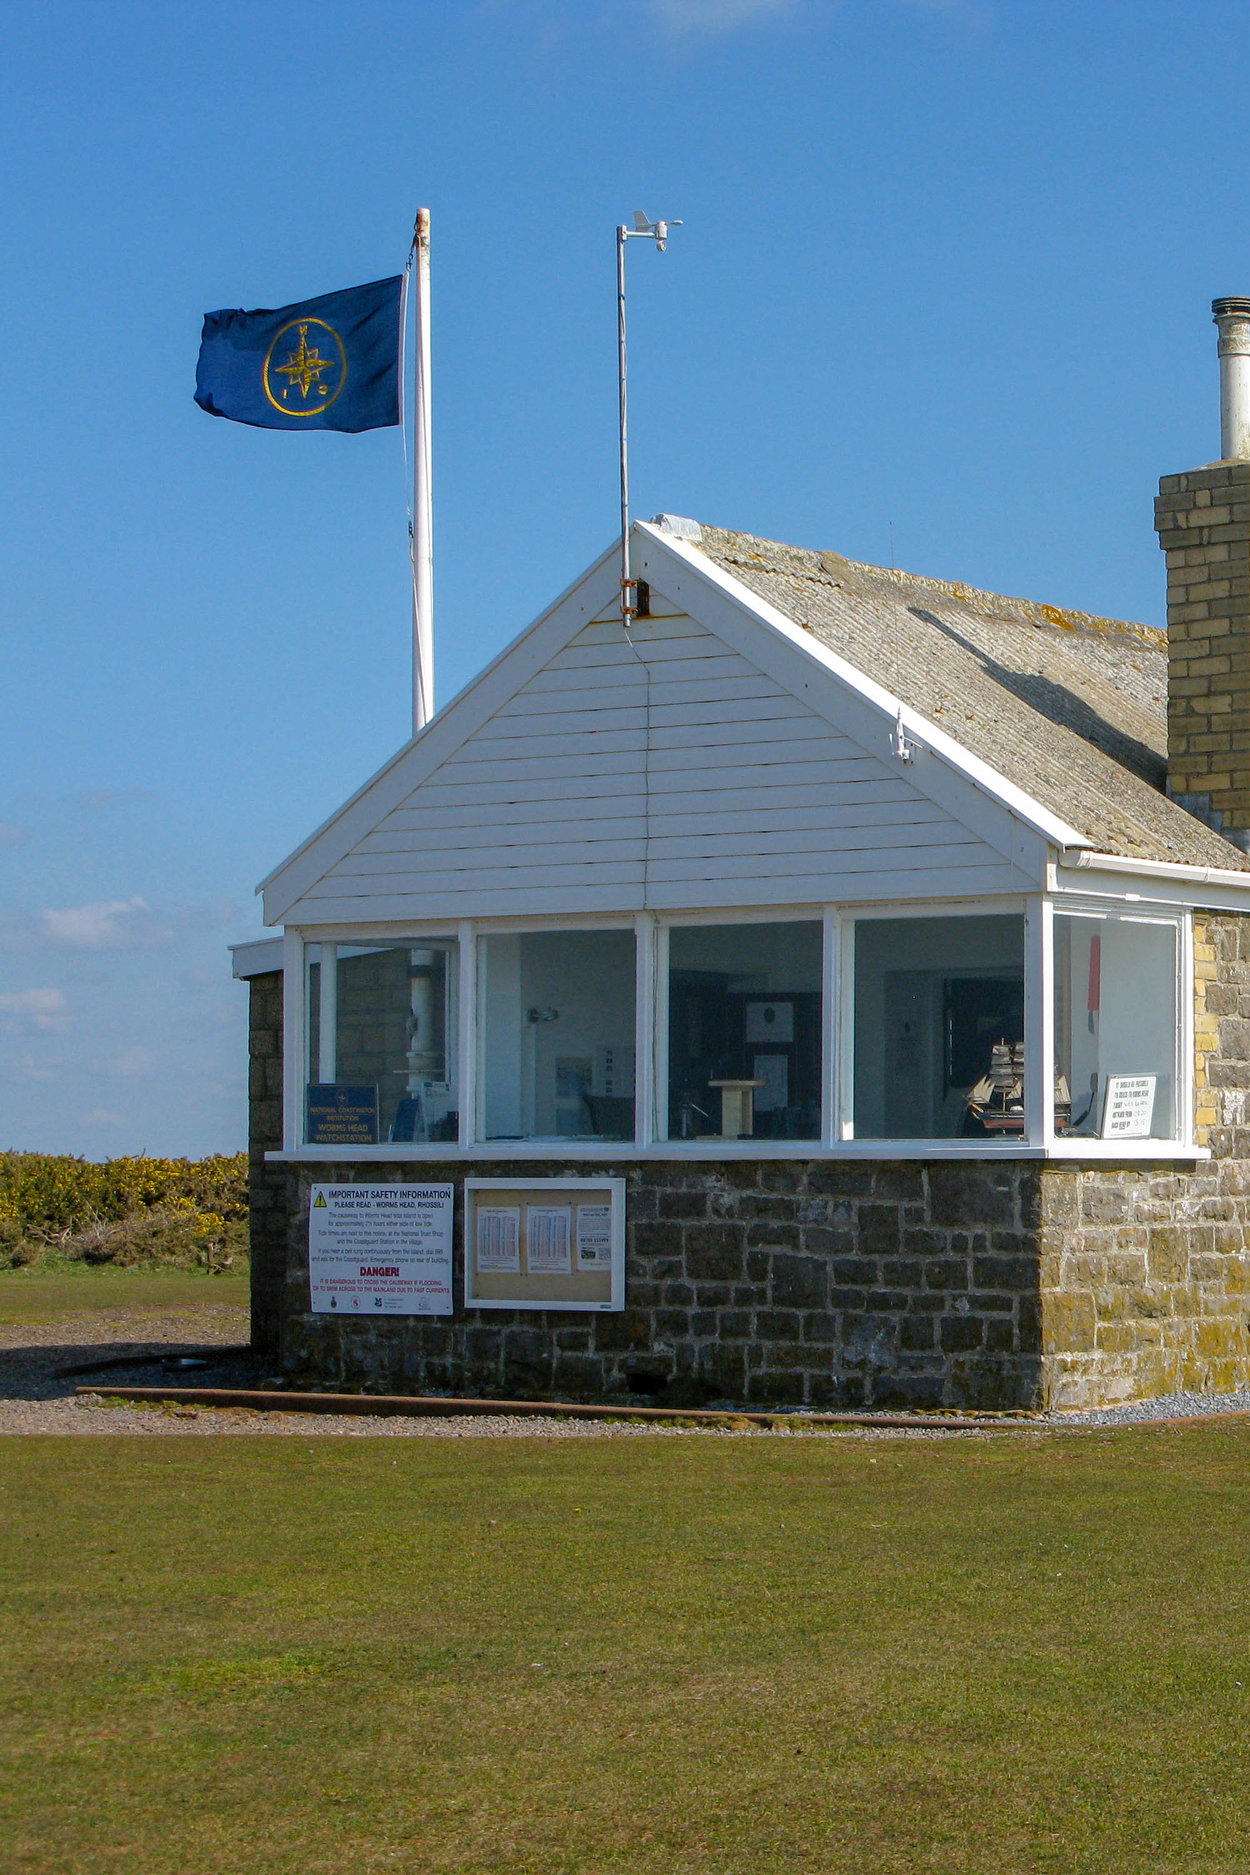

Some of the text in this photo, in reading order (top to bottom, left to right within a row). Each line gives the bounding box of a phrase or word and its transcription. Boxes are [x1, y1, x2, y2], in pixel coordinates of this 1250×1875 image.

[329, 1190, 451, 1199] IMPORTANT SAFETY INFORMATION
[360, 1267, 400, 1276] DANGER!
